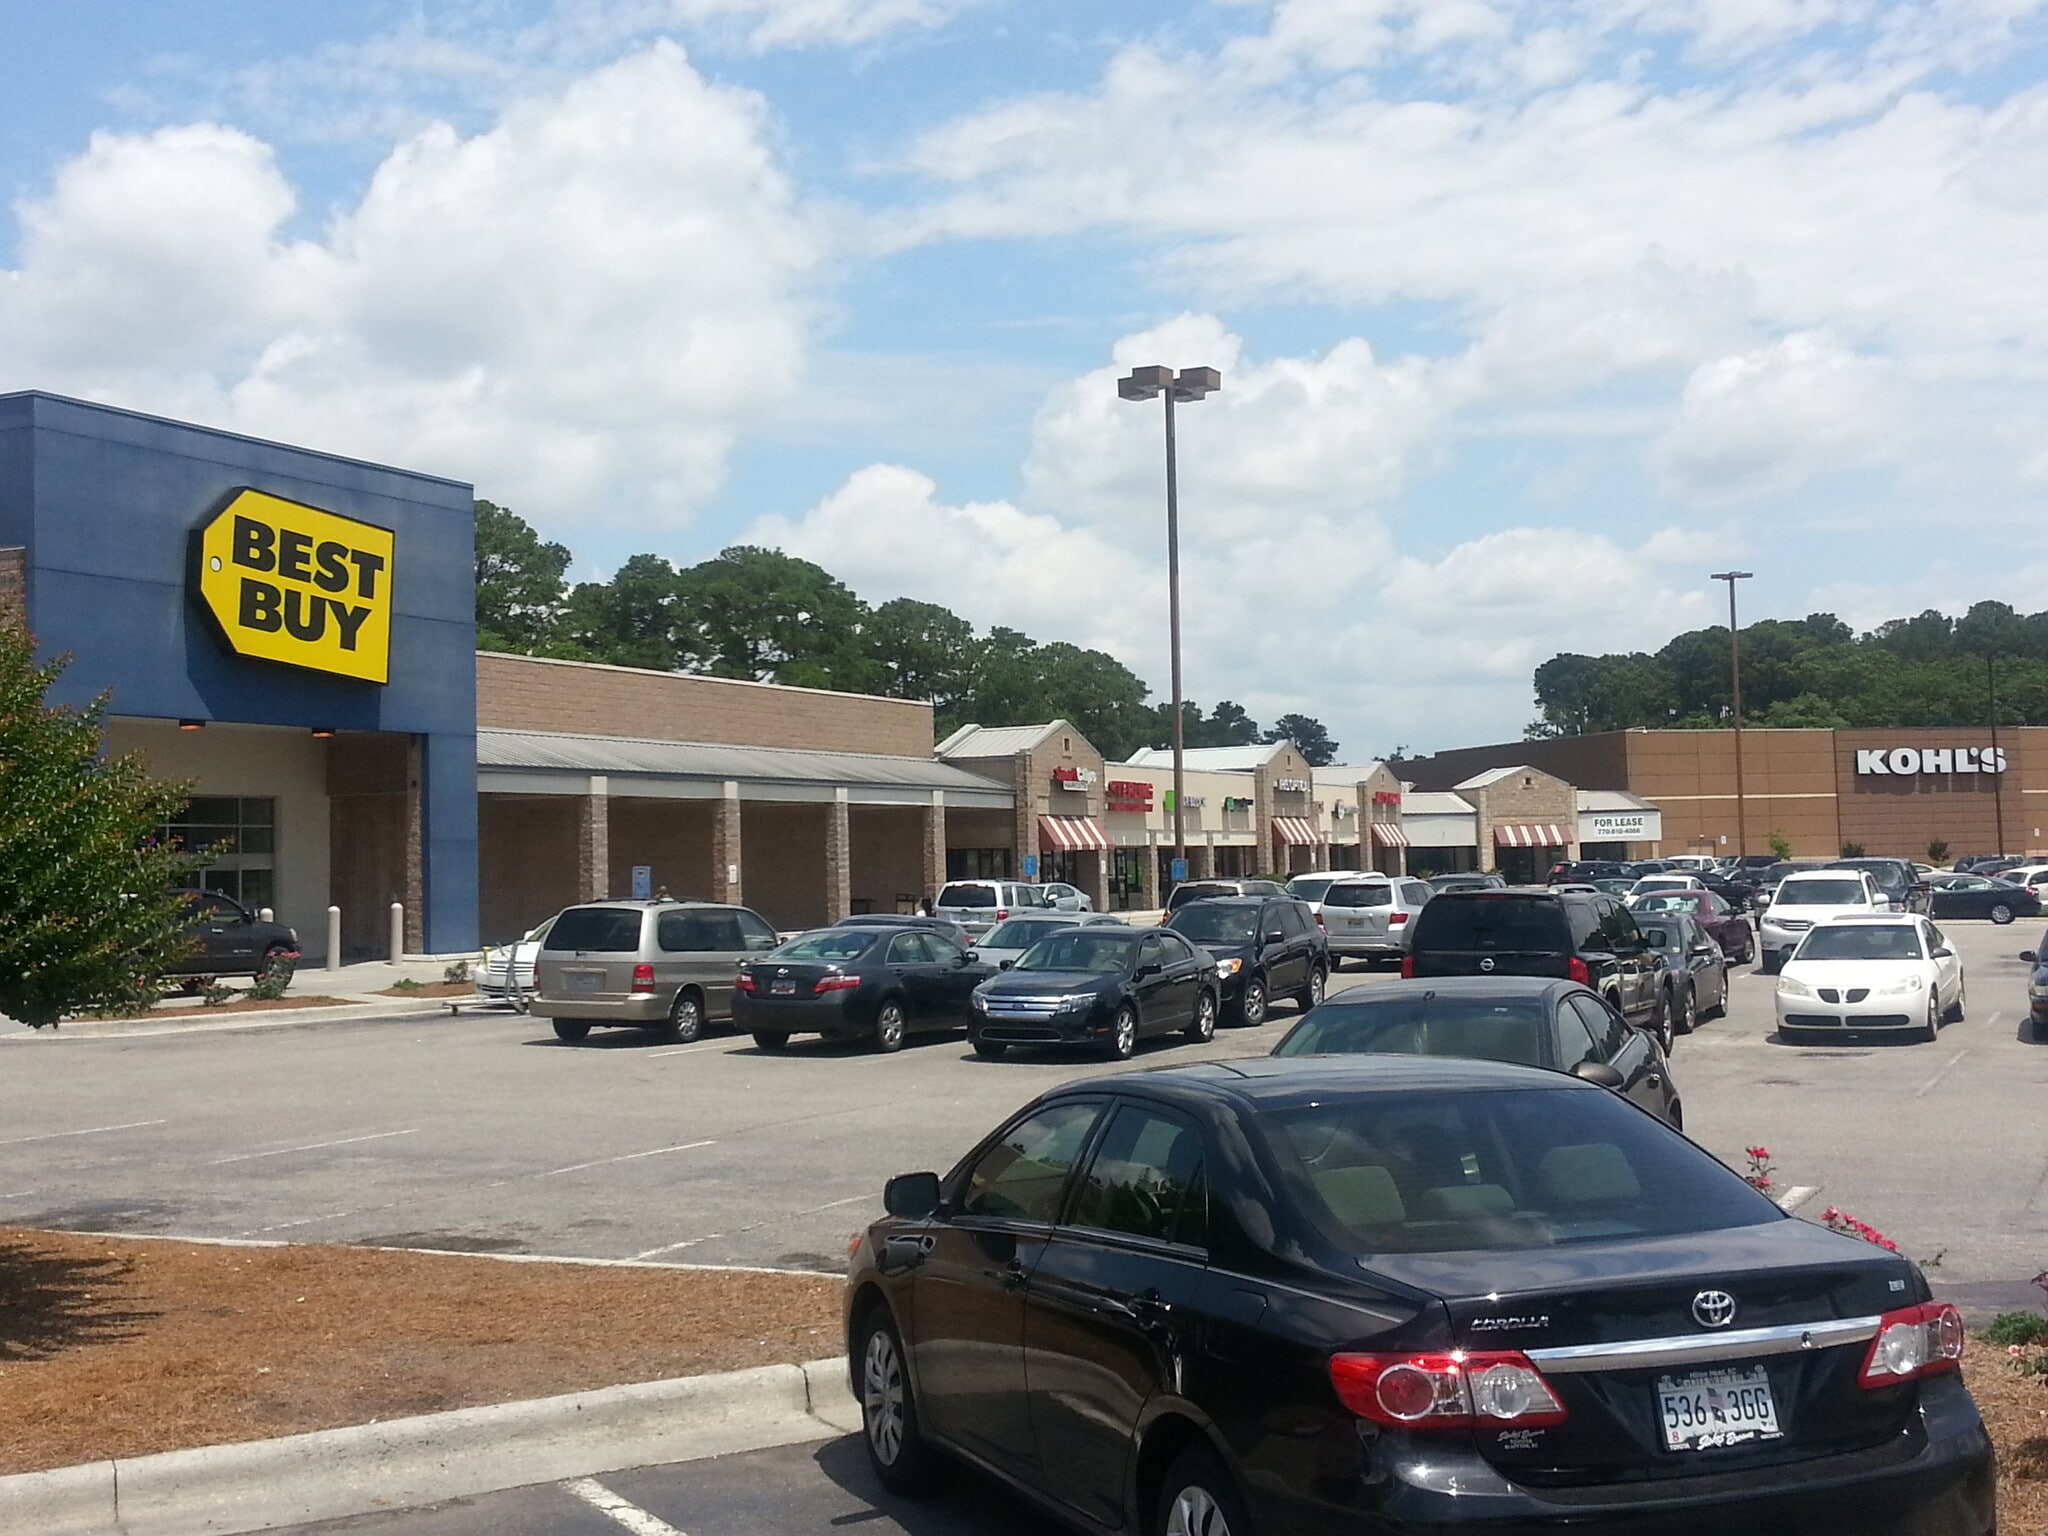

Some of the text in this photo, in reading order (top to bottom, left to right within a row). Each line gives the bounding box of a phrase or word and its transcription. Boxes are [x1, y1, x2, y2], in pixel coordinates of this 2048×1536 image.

[232, 514, 384, 600] BEST
[238, 576, 372, 651] BUY
[1857, 747, 2007, 775] KOHL'S
[1594, 817, 1643, 827] FOR LEASE
[1471, 1315, 1549, 1331] COROLLA
[1664, 1387, 1769, 1428] 536 3GG
